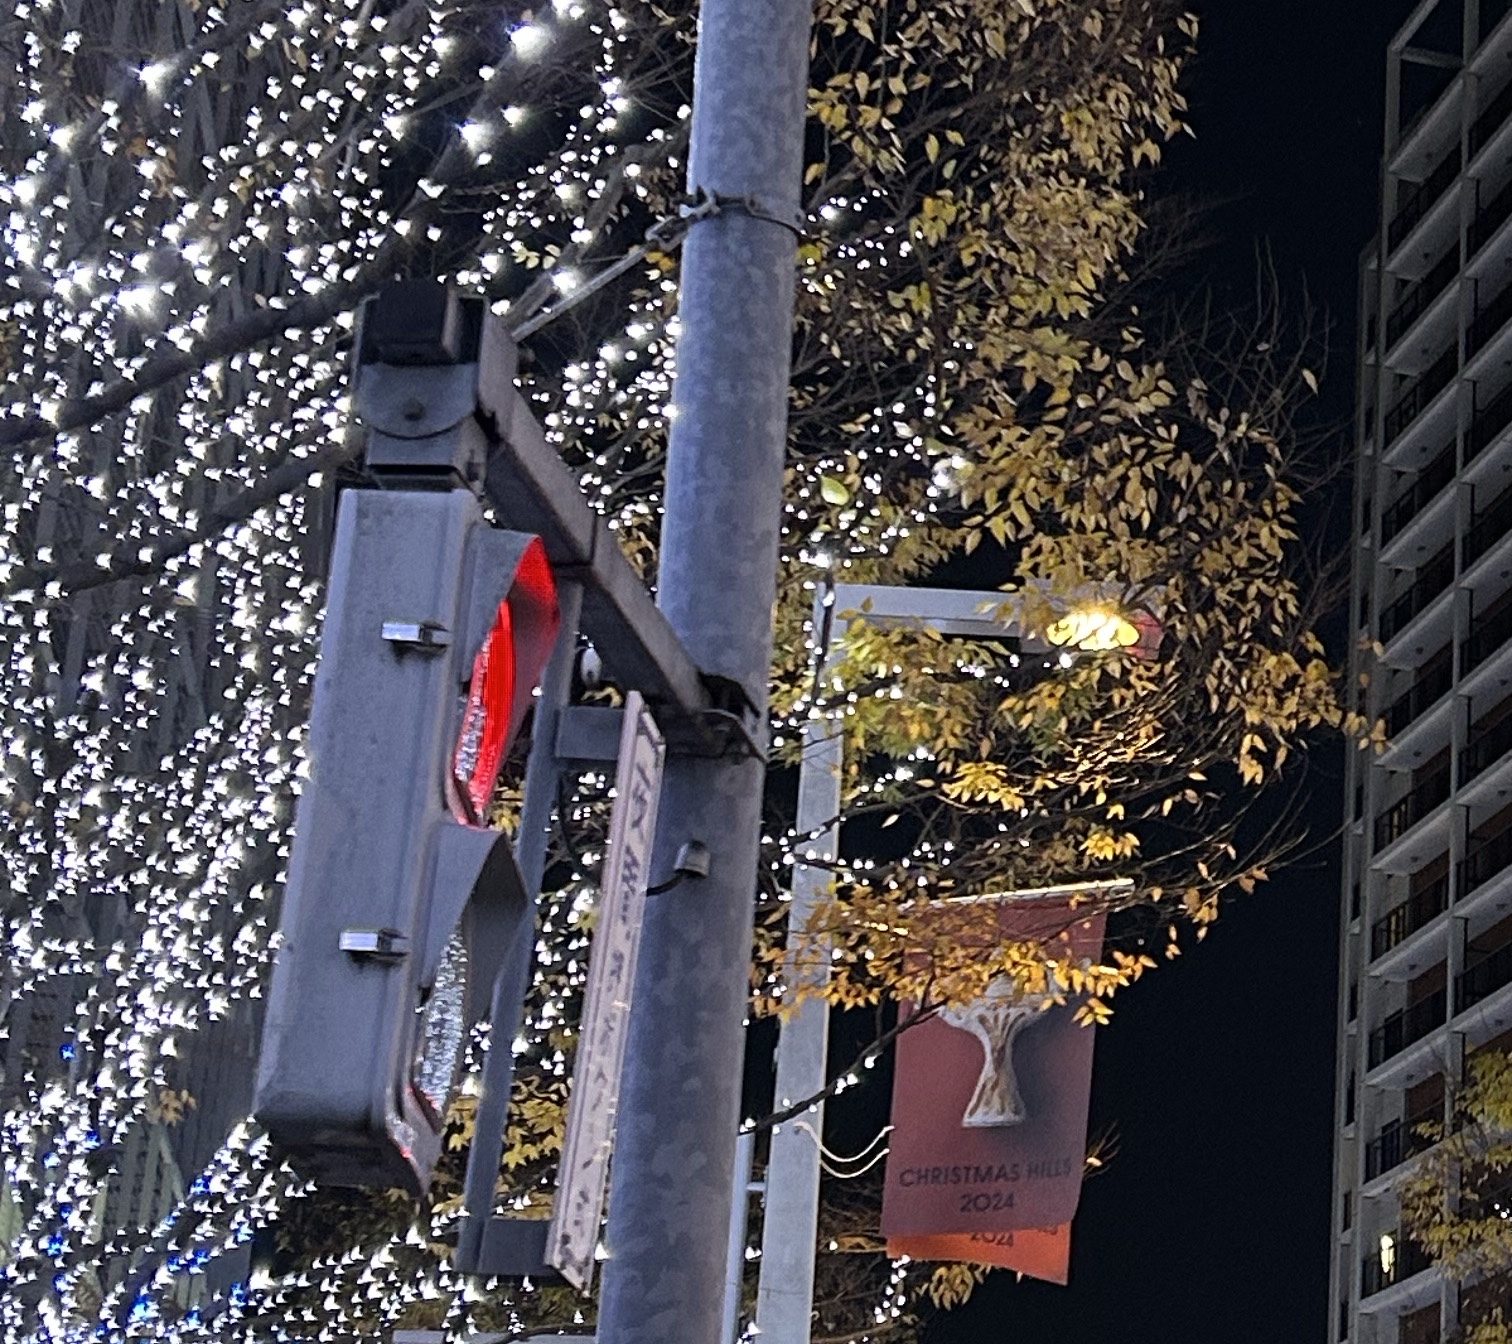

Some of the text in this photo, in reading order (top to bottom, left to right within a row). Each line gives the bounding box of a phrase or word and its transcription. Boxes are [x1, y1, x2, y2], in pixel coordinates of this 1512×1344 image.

[900, 1158, 1072, 1187] CHRISTMAS HILLS
[960, 1193, 1015, 1213] 2024
